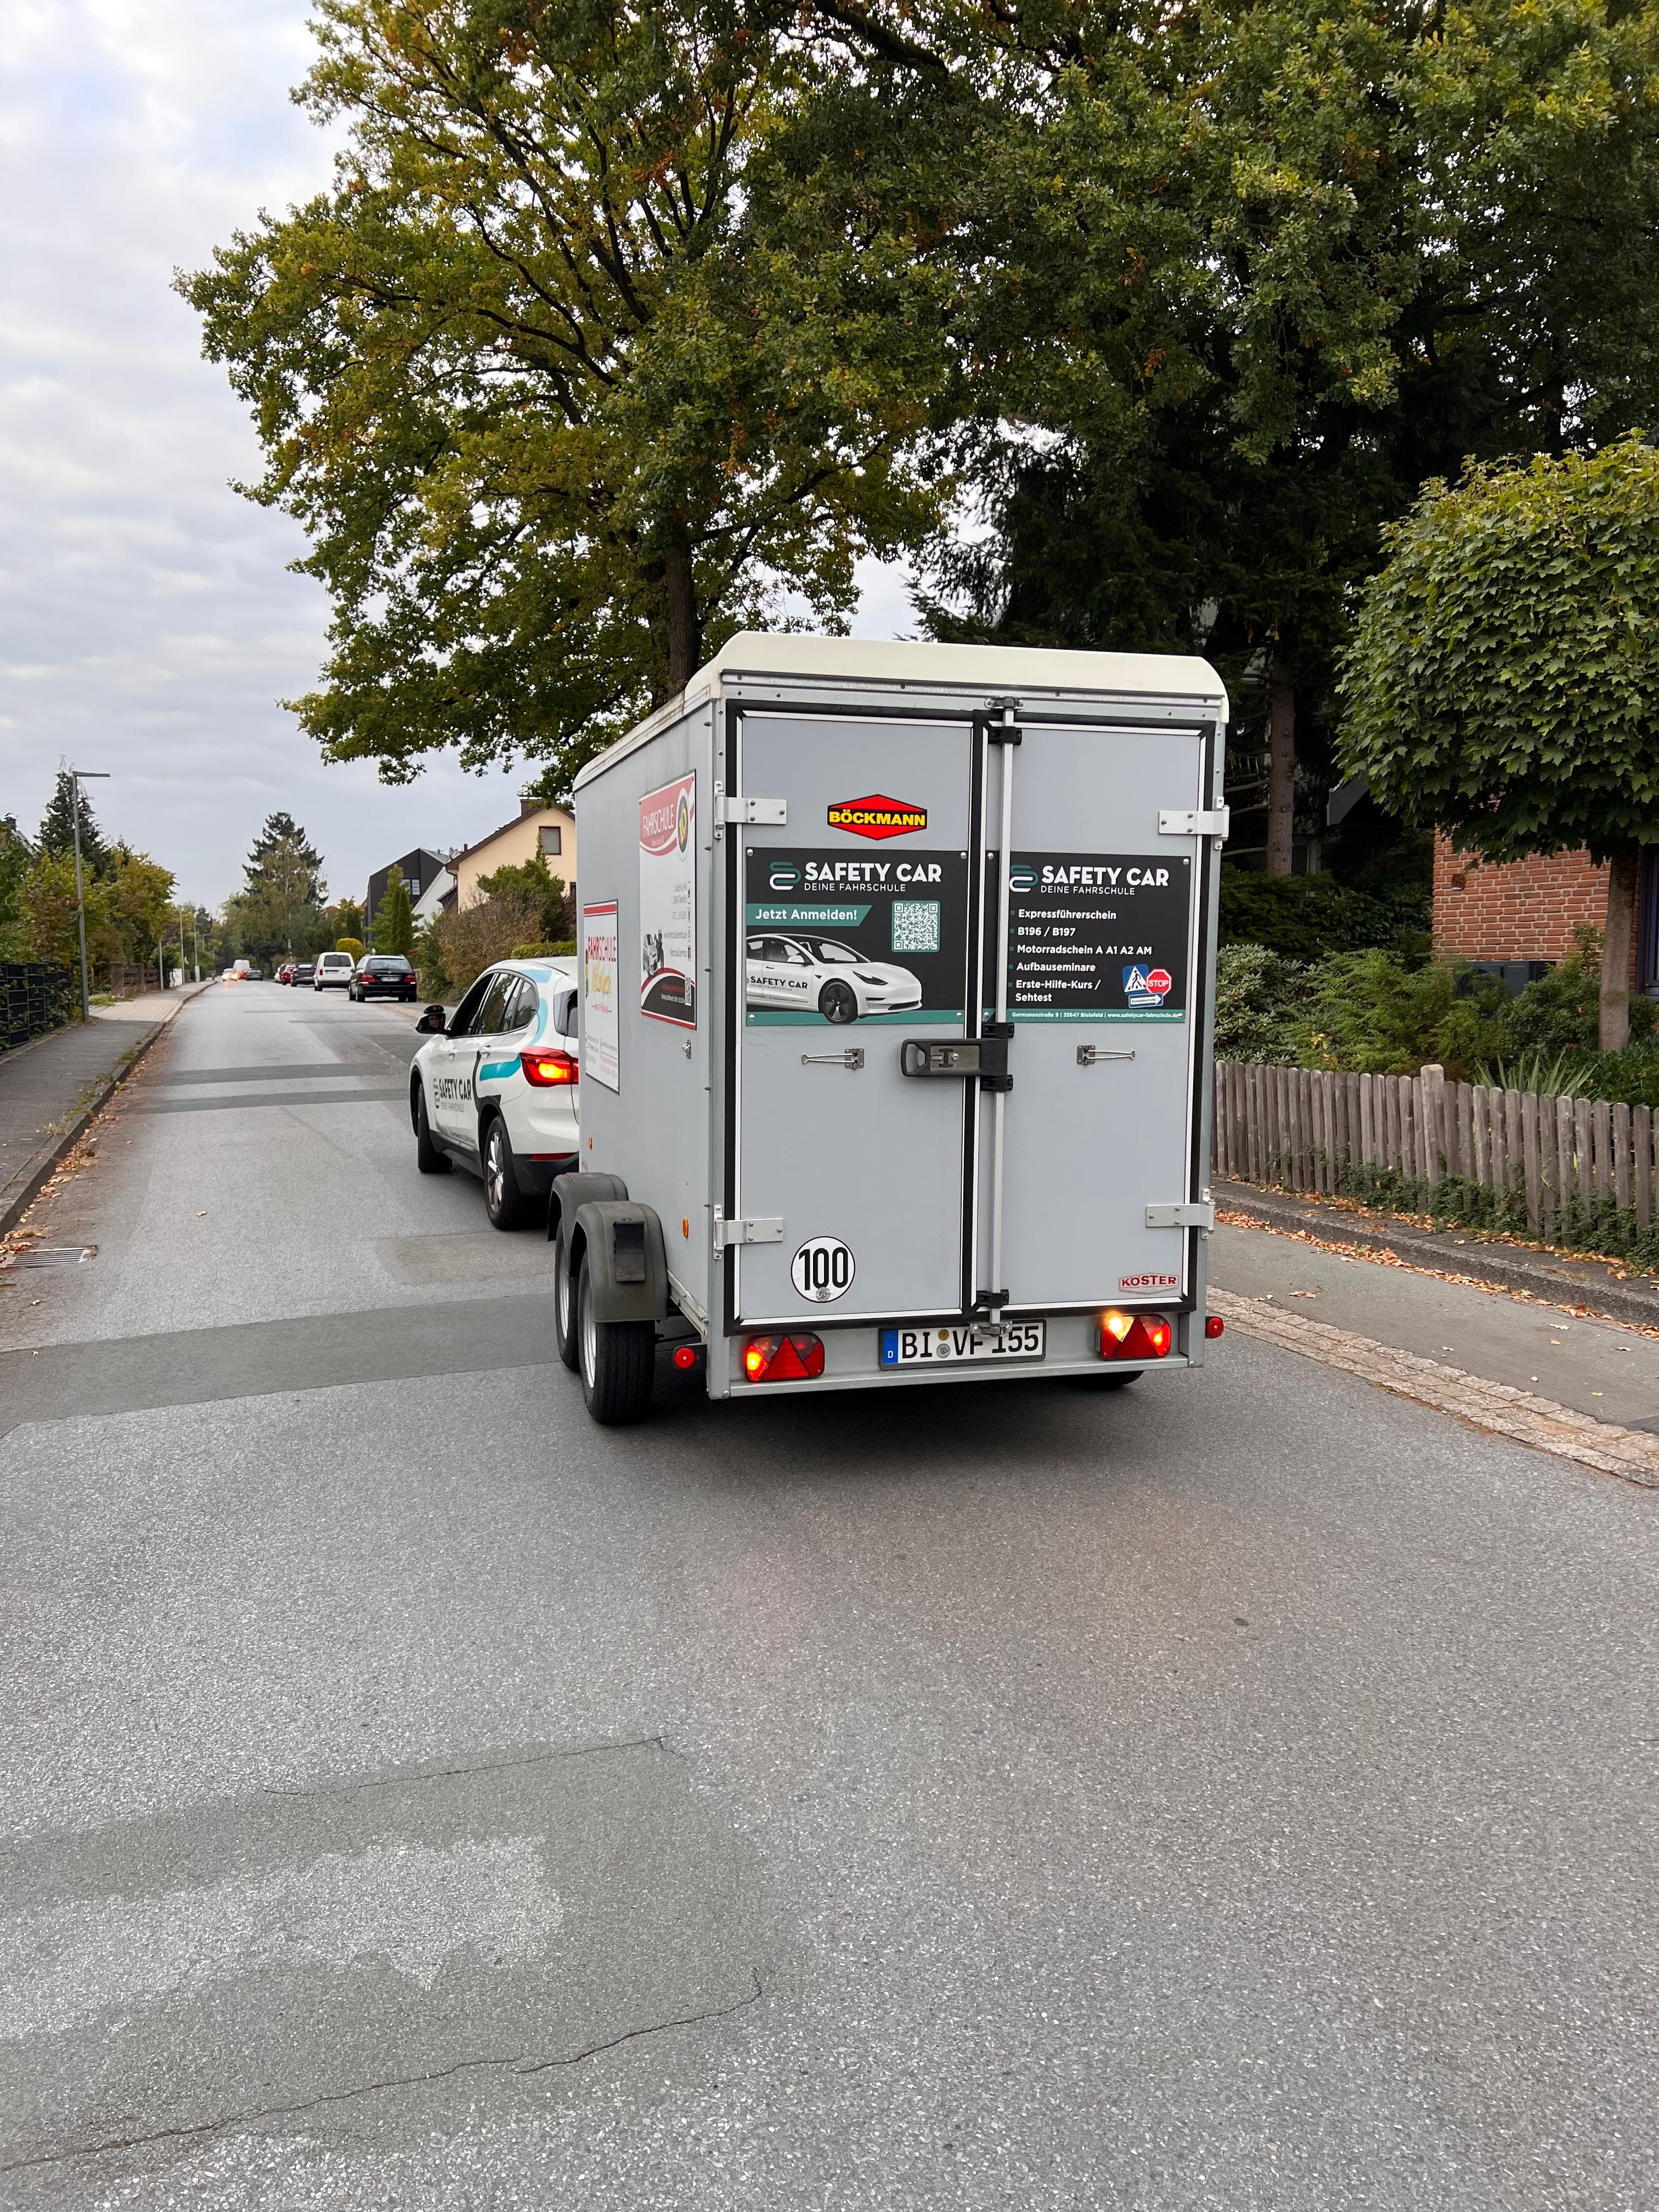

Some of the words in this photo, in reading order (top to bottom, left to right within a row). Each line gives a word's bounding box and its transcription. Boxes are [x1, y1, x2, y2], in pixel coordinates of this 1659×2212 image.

[643, 804, 674, 838] FAHRSCHULE
[829, 809, 926, 826] BÖCKMANN
[805, 862, 891, 882] SAFETY
[896, 863, 942, 882] CAR
[1042, 866, 1122, 884] SAFETY
[1126, 868, 1169, 886] CAR
[839, 883, 906, 892] FAHRSCHULE
[1041, 885, 1069, 894] DEINE
[1073, 886, 1135, 895] FAHRSCHULE
[755, 909, 787, 919] Jetzt
[791, 909, 857, 920] Anmelden!
[1018, 909, 1116, 919] Expressführerschein
[1018, 927, 1042, 936] B196
[1044, 927, 1050, 937] /
[1052, 928, 1076, 936] B197
[1017, 945, 1093, 954] Motorradschein
[1096, 946, 1103, 954] A
[1106, 946, 1117, 954] A1
[1120, 946, 1134, 955] A2
[1136, 946, 1152, 955] AM
[1016, 962, 1096, 972] Aufbauseminare
[751, 977, 786, 986] SAFETY
[1016, 980, 1093, 989] Erste-Hilfe-Kurs
[1094, 979, 1101, 990] /
[1148, 979, 1169, 988] STOP
[1015, 993, 1052, 1002] Sehtest
[439, 1079, 458, 1100] SAFETY
[459, 1079, 471, 1101] CAR
[799, 1247, 849, 1290] 100
[1122, 1276, 1177, 1286] KÖSTER
[902, 1332, 932, 1359] BI
